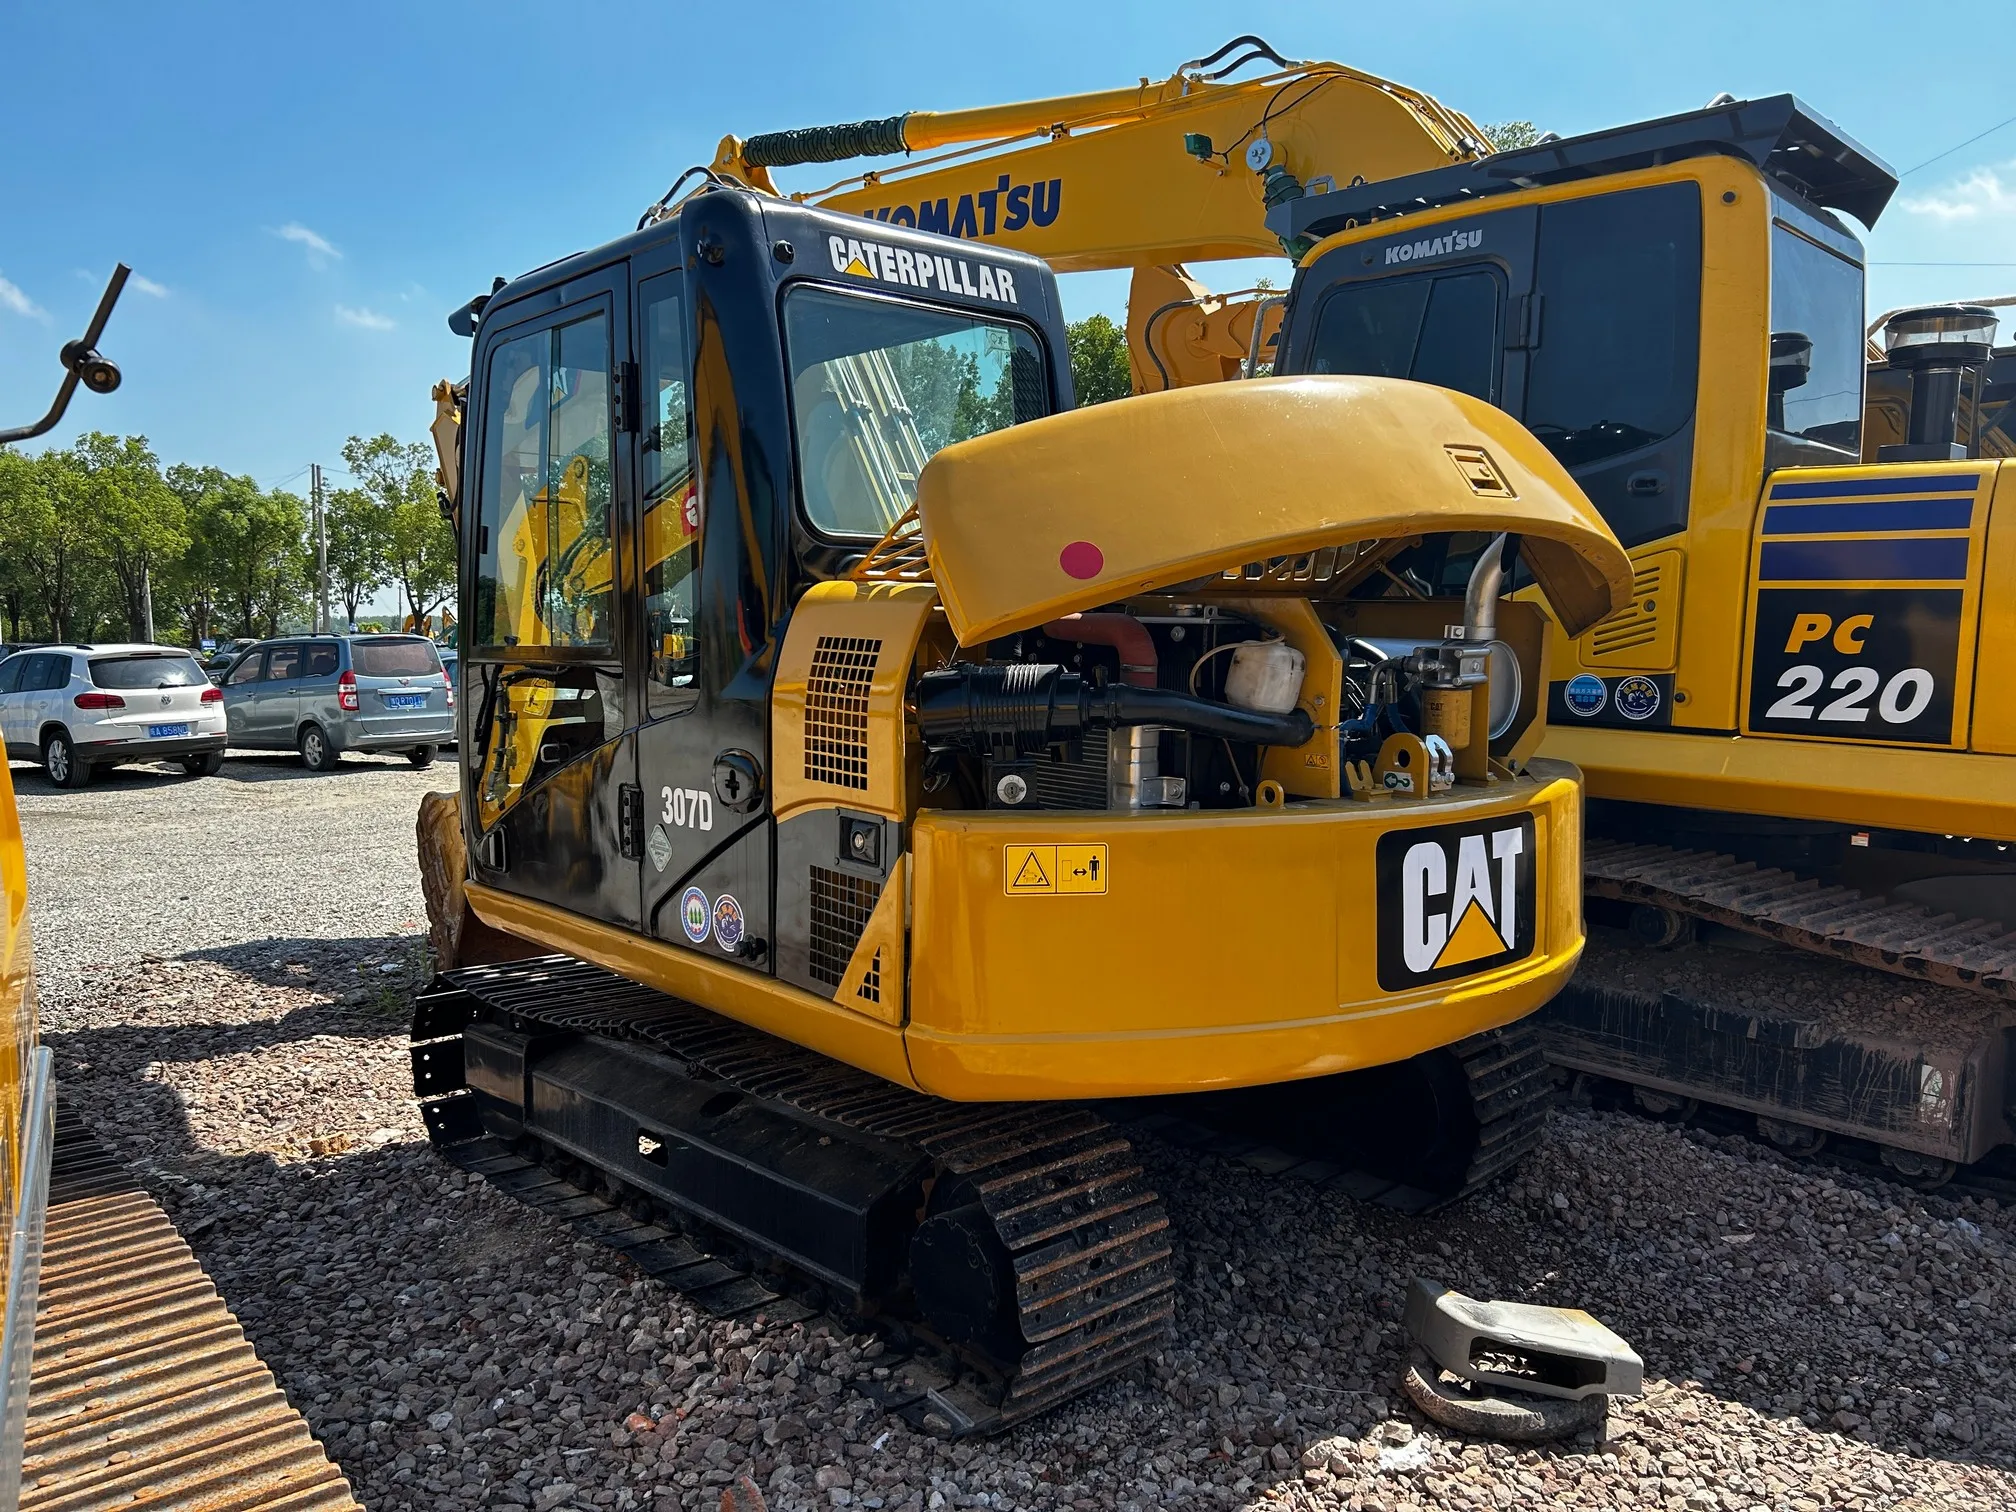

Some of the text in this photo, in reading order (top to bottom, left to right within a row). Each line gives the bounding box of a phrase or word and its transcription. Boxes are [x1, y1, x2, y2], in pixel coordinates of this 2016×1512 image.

[828, 235, 1018, 304] CATERPILLAR
[1385, 229, 1483, 264] KOMATSU
[1784, 613, 1875, 655] PC
[1765, 664, 1935, 724] 220
[661, 785, 713, 832] 307D
[1402, 827, 1523, 973] CAT
